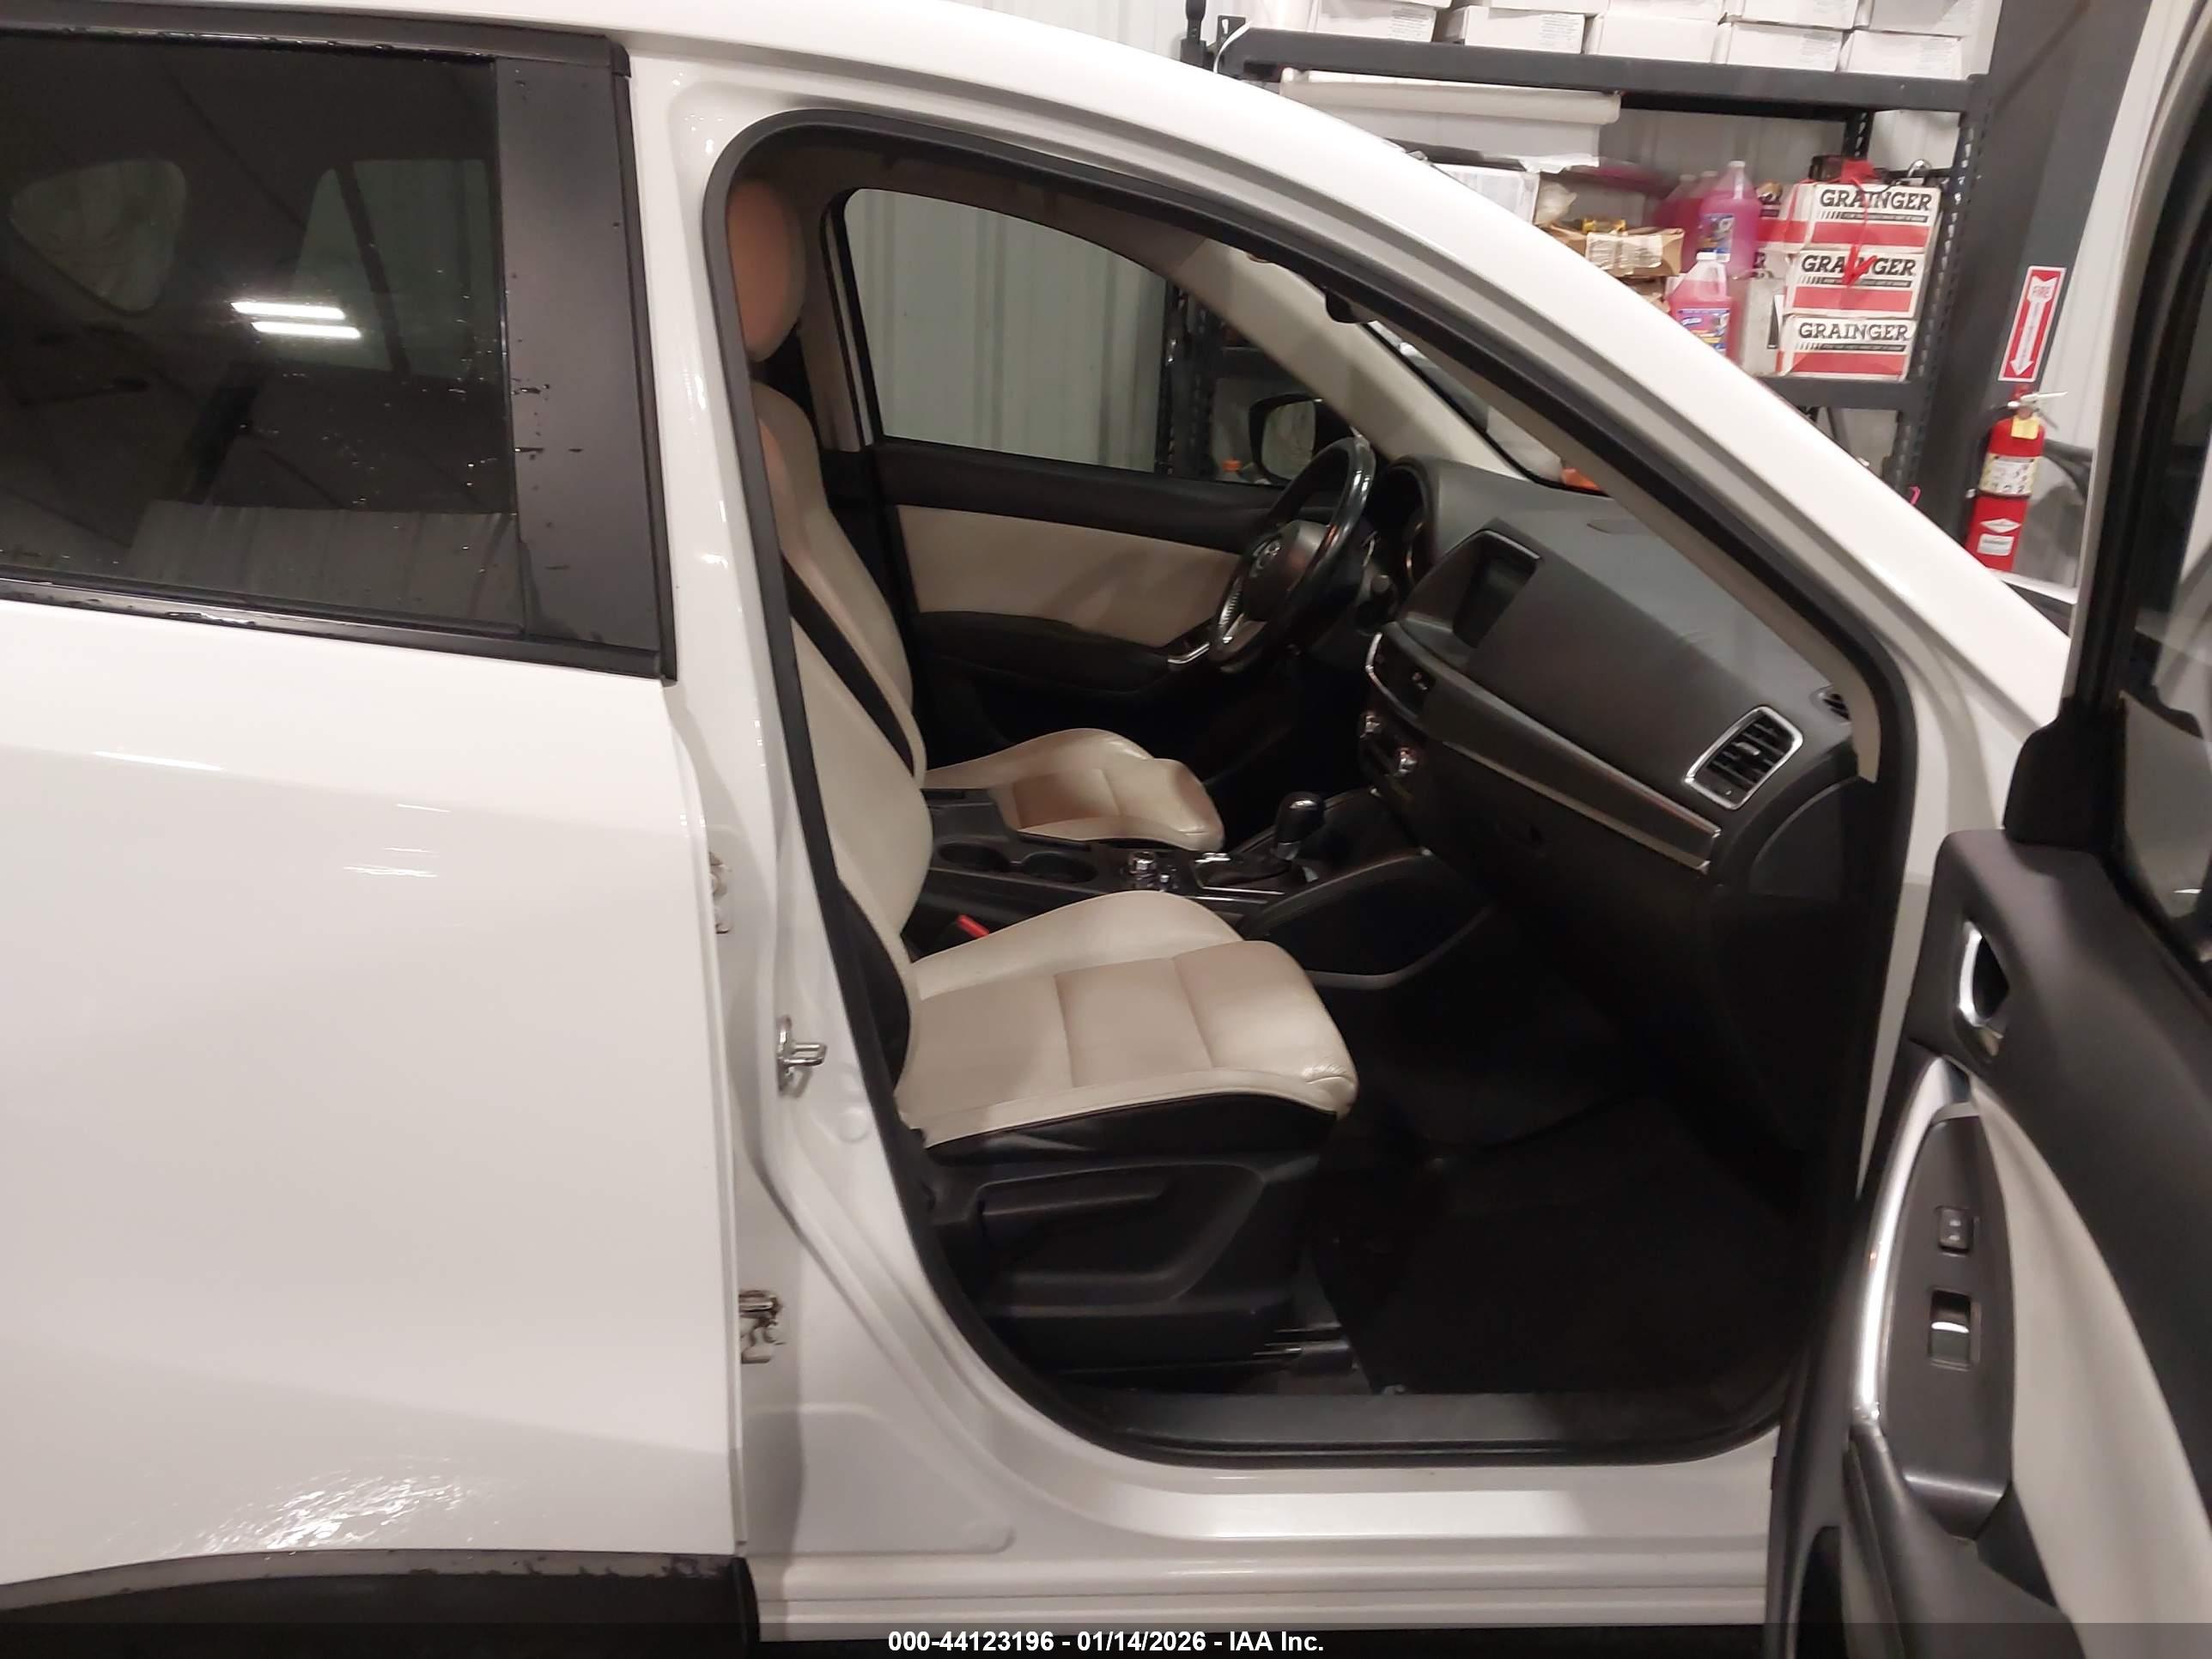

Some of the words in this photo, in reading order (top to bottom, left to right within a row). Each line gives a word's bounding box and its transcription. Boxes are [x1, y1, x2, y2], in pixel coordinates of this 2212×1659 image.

[1820, 189, 1932, 211] GRAINGER
[1801, 254, 1916, 276] GRAGER
[1799, 322, 1908, 342] GRAINGER
